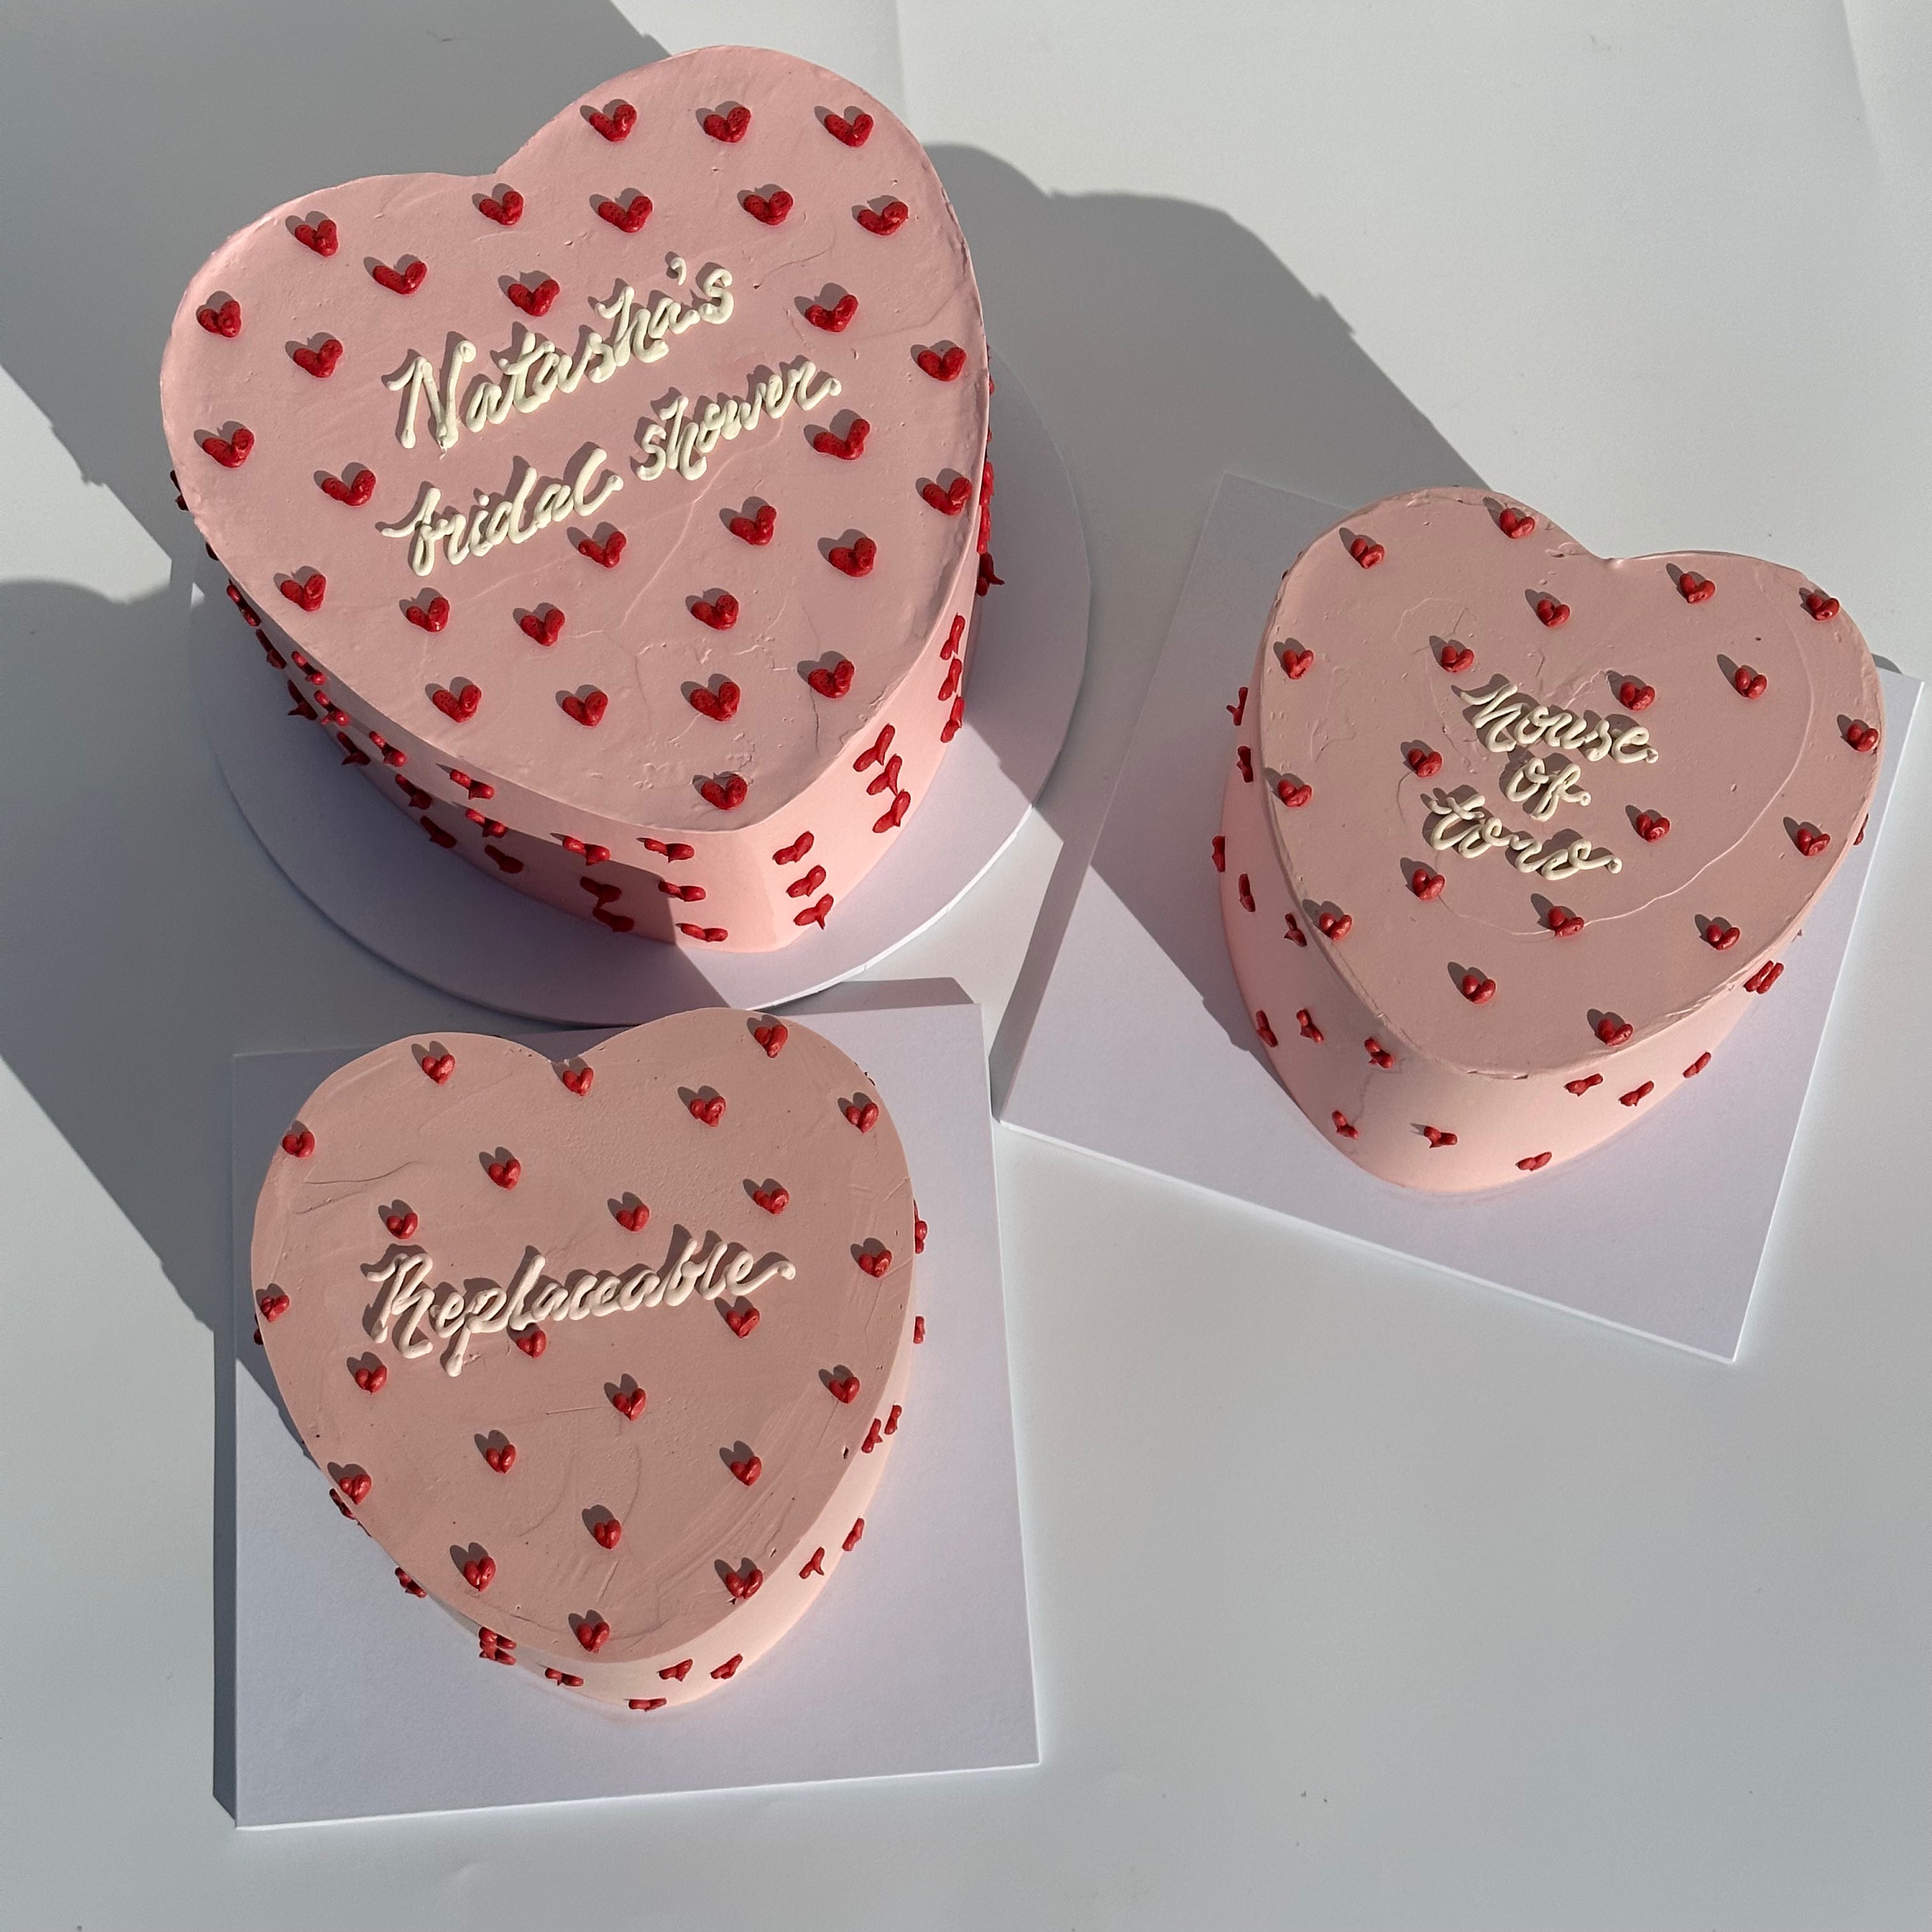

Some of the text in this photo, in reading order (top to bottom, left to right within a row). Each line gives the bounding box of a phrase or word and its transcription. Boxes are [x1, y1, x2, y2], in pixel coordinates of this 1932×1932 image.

[387, 256, 735, 451] Natasha's
[638, 360, 843, 481] shower
[1505, 757, 1592, 822] of
[367, 1238, 797, 1377] Replaceable
